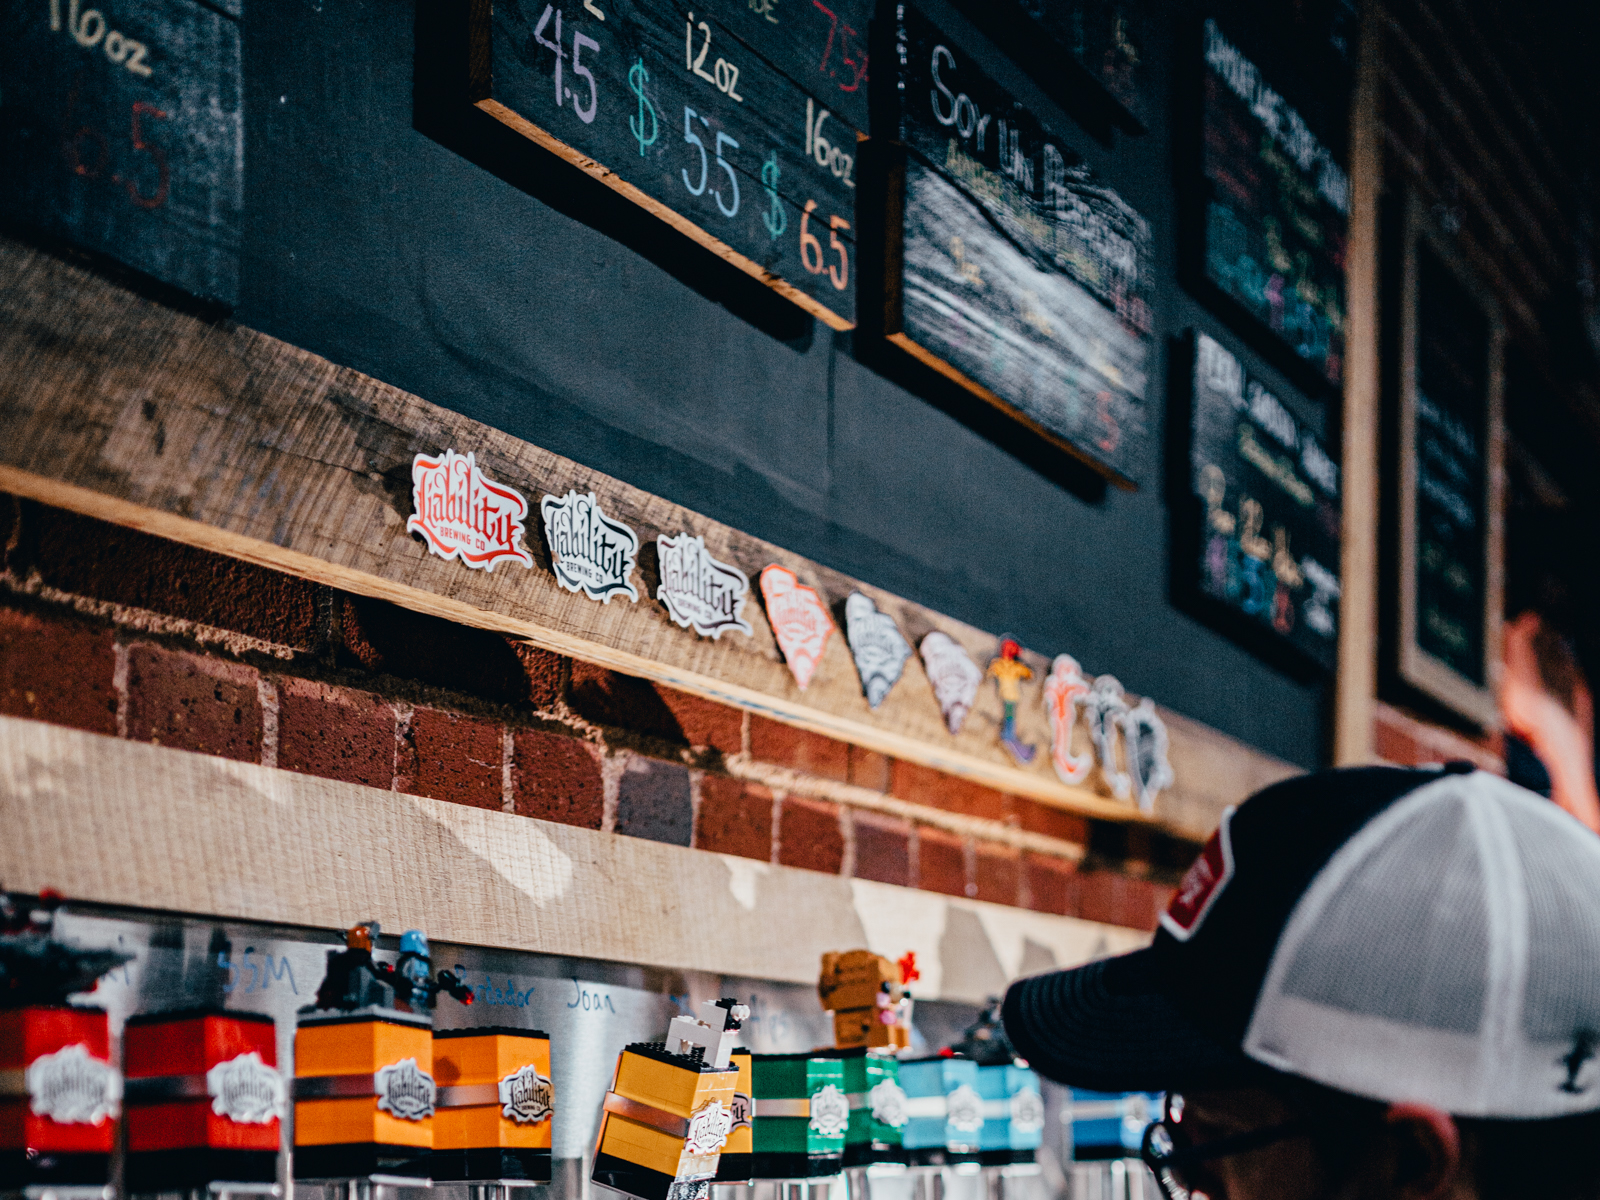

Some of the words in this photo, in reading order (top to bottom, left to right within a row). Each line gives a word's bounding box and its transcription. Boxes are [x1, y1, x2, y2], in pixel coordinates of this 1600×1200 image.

[533, 3, 600, 124] 4.5
[686, 11, 743, 102] 12oz
[629, 57, 659, 157] $
[682, 106, 740, 218] 5.5
[805, 97, 856, 188] 16oz
[761, 150, 787, 241] $
[800, 200, 851, 291] 6.5
[440, 526, 471, 546] BREWING
[475, 537, 486, 552] CO
[566, 561, 593, 579] BREWING
